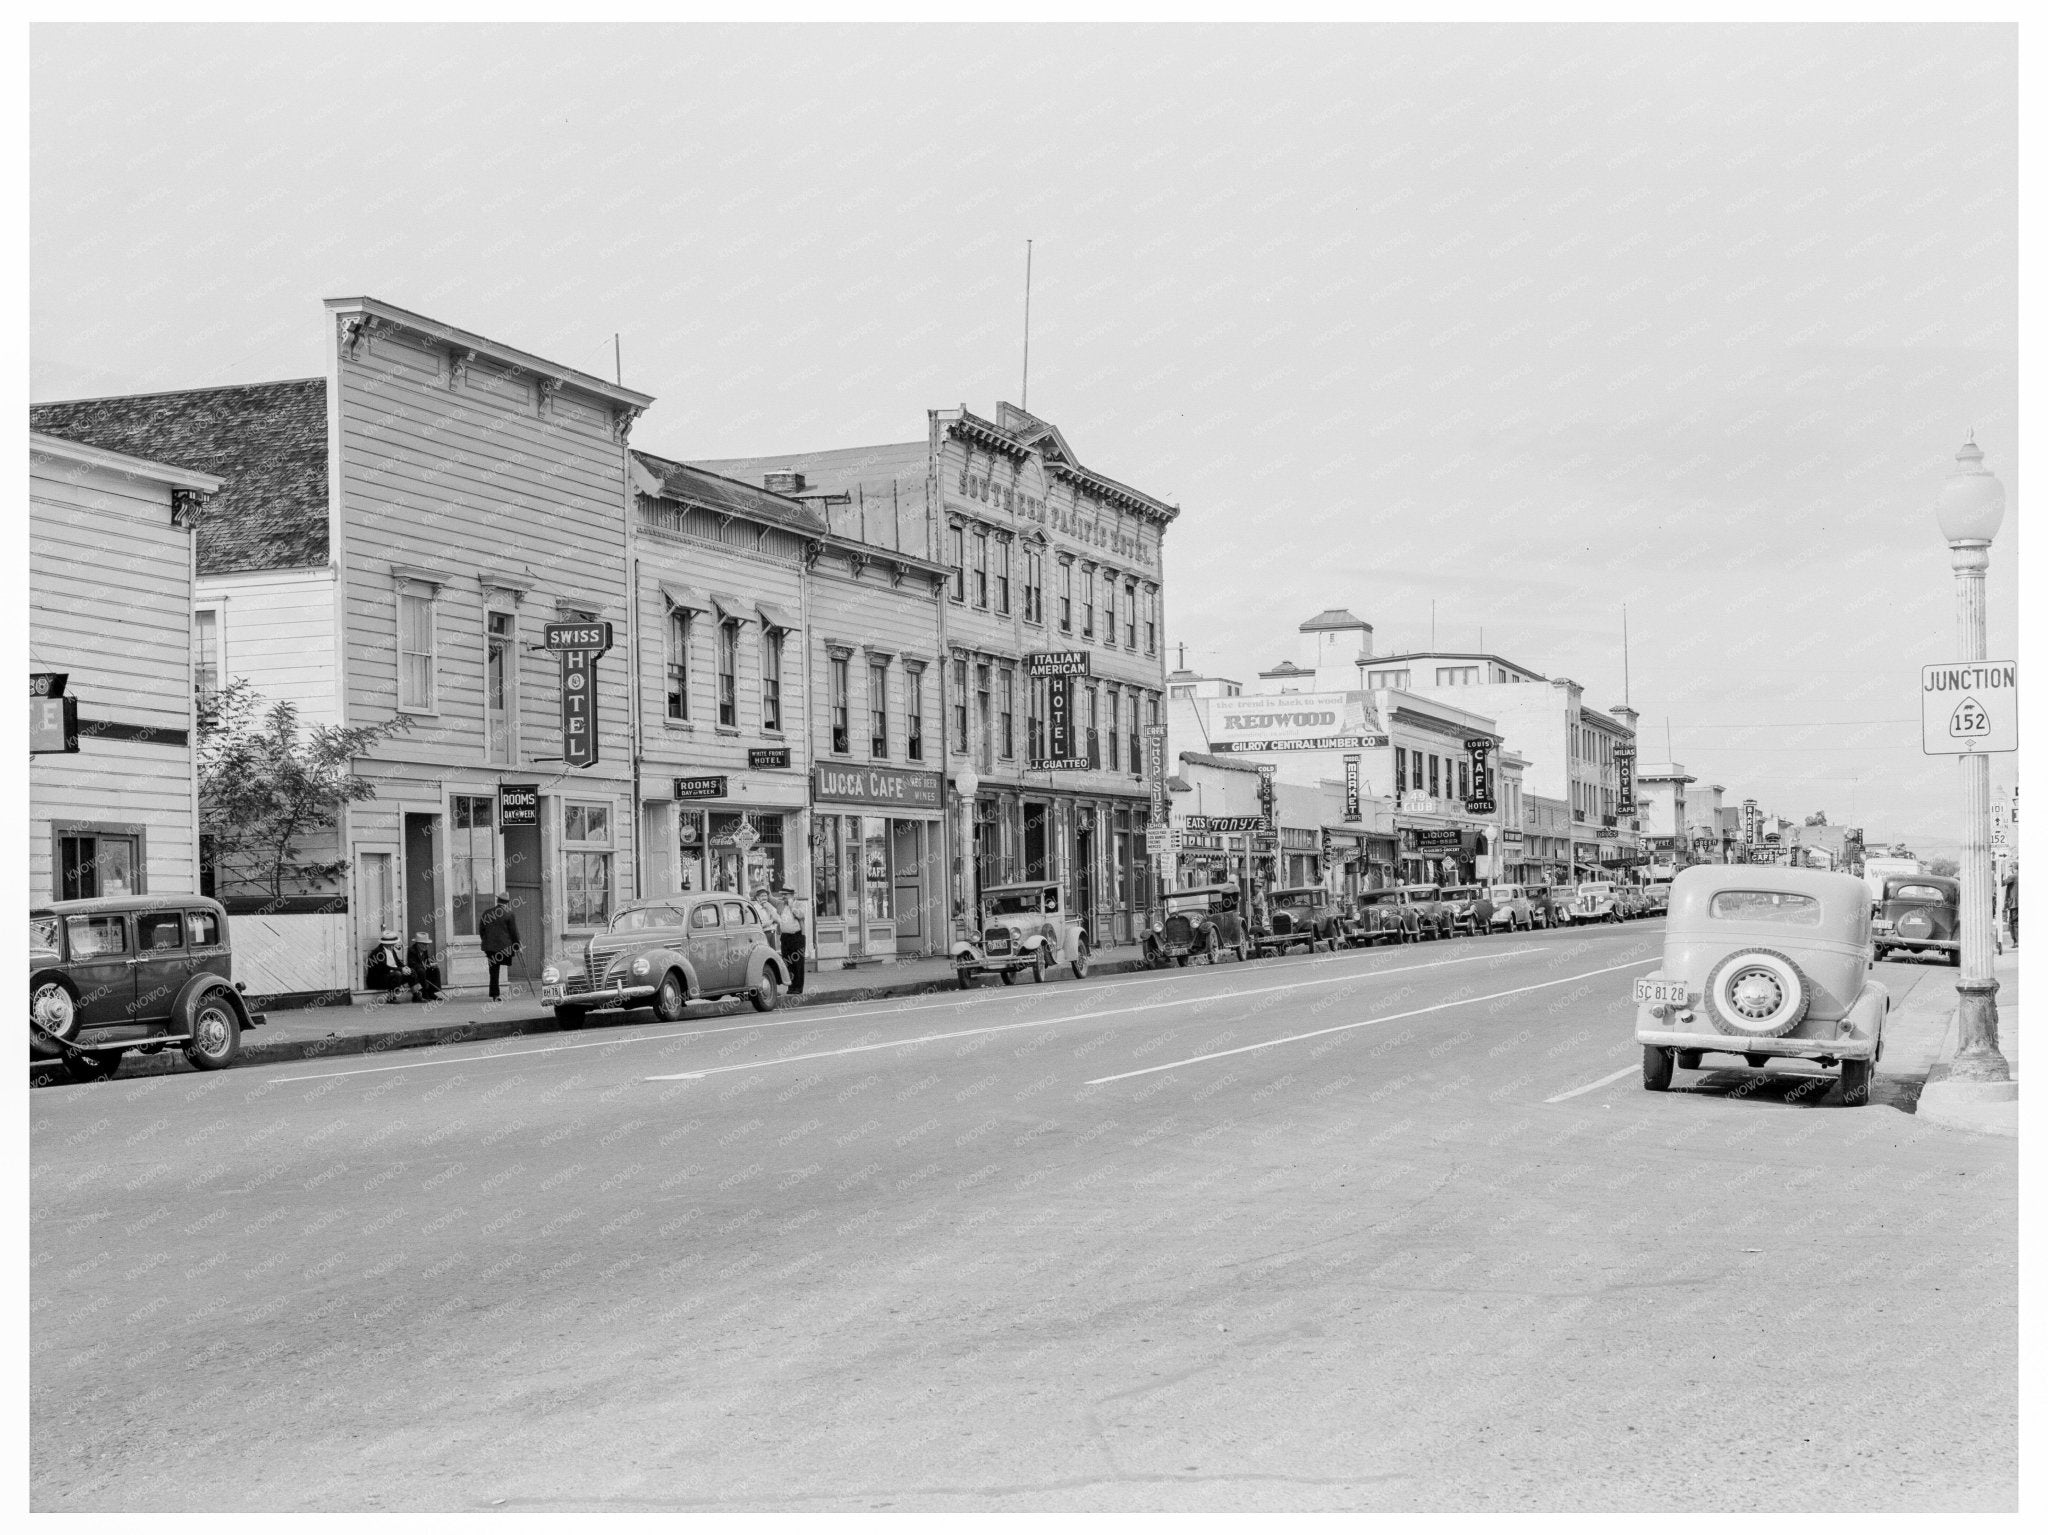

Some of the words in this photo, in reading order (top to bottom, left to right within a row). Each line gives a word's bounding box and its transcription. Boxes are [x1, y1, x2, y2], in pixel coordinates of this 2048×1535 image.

[959, 469, 1046, 524] SOUTHERN
[1110, 529, 1154, 566] HOTEL
[550, 630, 599, 643] SWISS
[1034, 653, 1081, 665] ITALIAN
[1030, 663, 1085, 675] AMERICAN
[1924, 667, 2014, 692] JUNCTION
[567, 651, 585, 756] HOTEL
[1238, 700, 1264, 708] trend
[1278, 699, 1302, 707] back
[1304, 698, 1314, 706] to
[1317, 696, 1343, 704] wood
[1053, 680, 1064, 754] HOTEL
[1224, 711, 1336, 730] REDWOOD
[1955, 713, 1985, 730] 152
[1146, 727, 1164, 735] CAFE
[1231, 741, 1269, 752] GILROY
[1271, 739, 1317, 750] CENTRAL
[1317, 738, 1358, 748] LUMBER
[1362, 737, 1375, 747] CO
[1032, 761, 1041, 769] J.
[1042, 759, 1087, 769] GUATTEO
[1474, 750, 1484, 799] CAFE
[681, 781, 717, 790] ROOMS
[820, 768, 864, 796] LUCCA
[869, 772, 904, 798] CAFE
[1348, 763, 1357, 813] MARKET
[1621, 759, 1630, 805] HOTEL
[503, 794, 535, 805] ROOMS
[914, 791, 935, 801] WINES
[1410, 792, 1426, 801] 49
[1404, 803, 1433, 811] CLUB
[1468, 802, 1493, 810] HOTEL
[504, 810, 515, 818] DAY
[520, 810, 535, 818] WEEK
[1186, 817, 1205, 828] EATS
[1212, 818, 1258, 831] TONY'S
[1991, 835, 2005, 843] 152
[867, 867, 885, 877] CAFE
[1638, 985, 1652, 999] 3C
[1655, 987, 1667, 1000] 81
[1671, 987, 1684, 1000] 28
